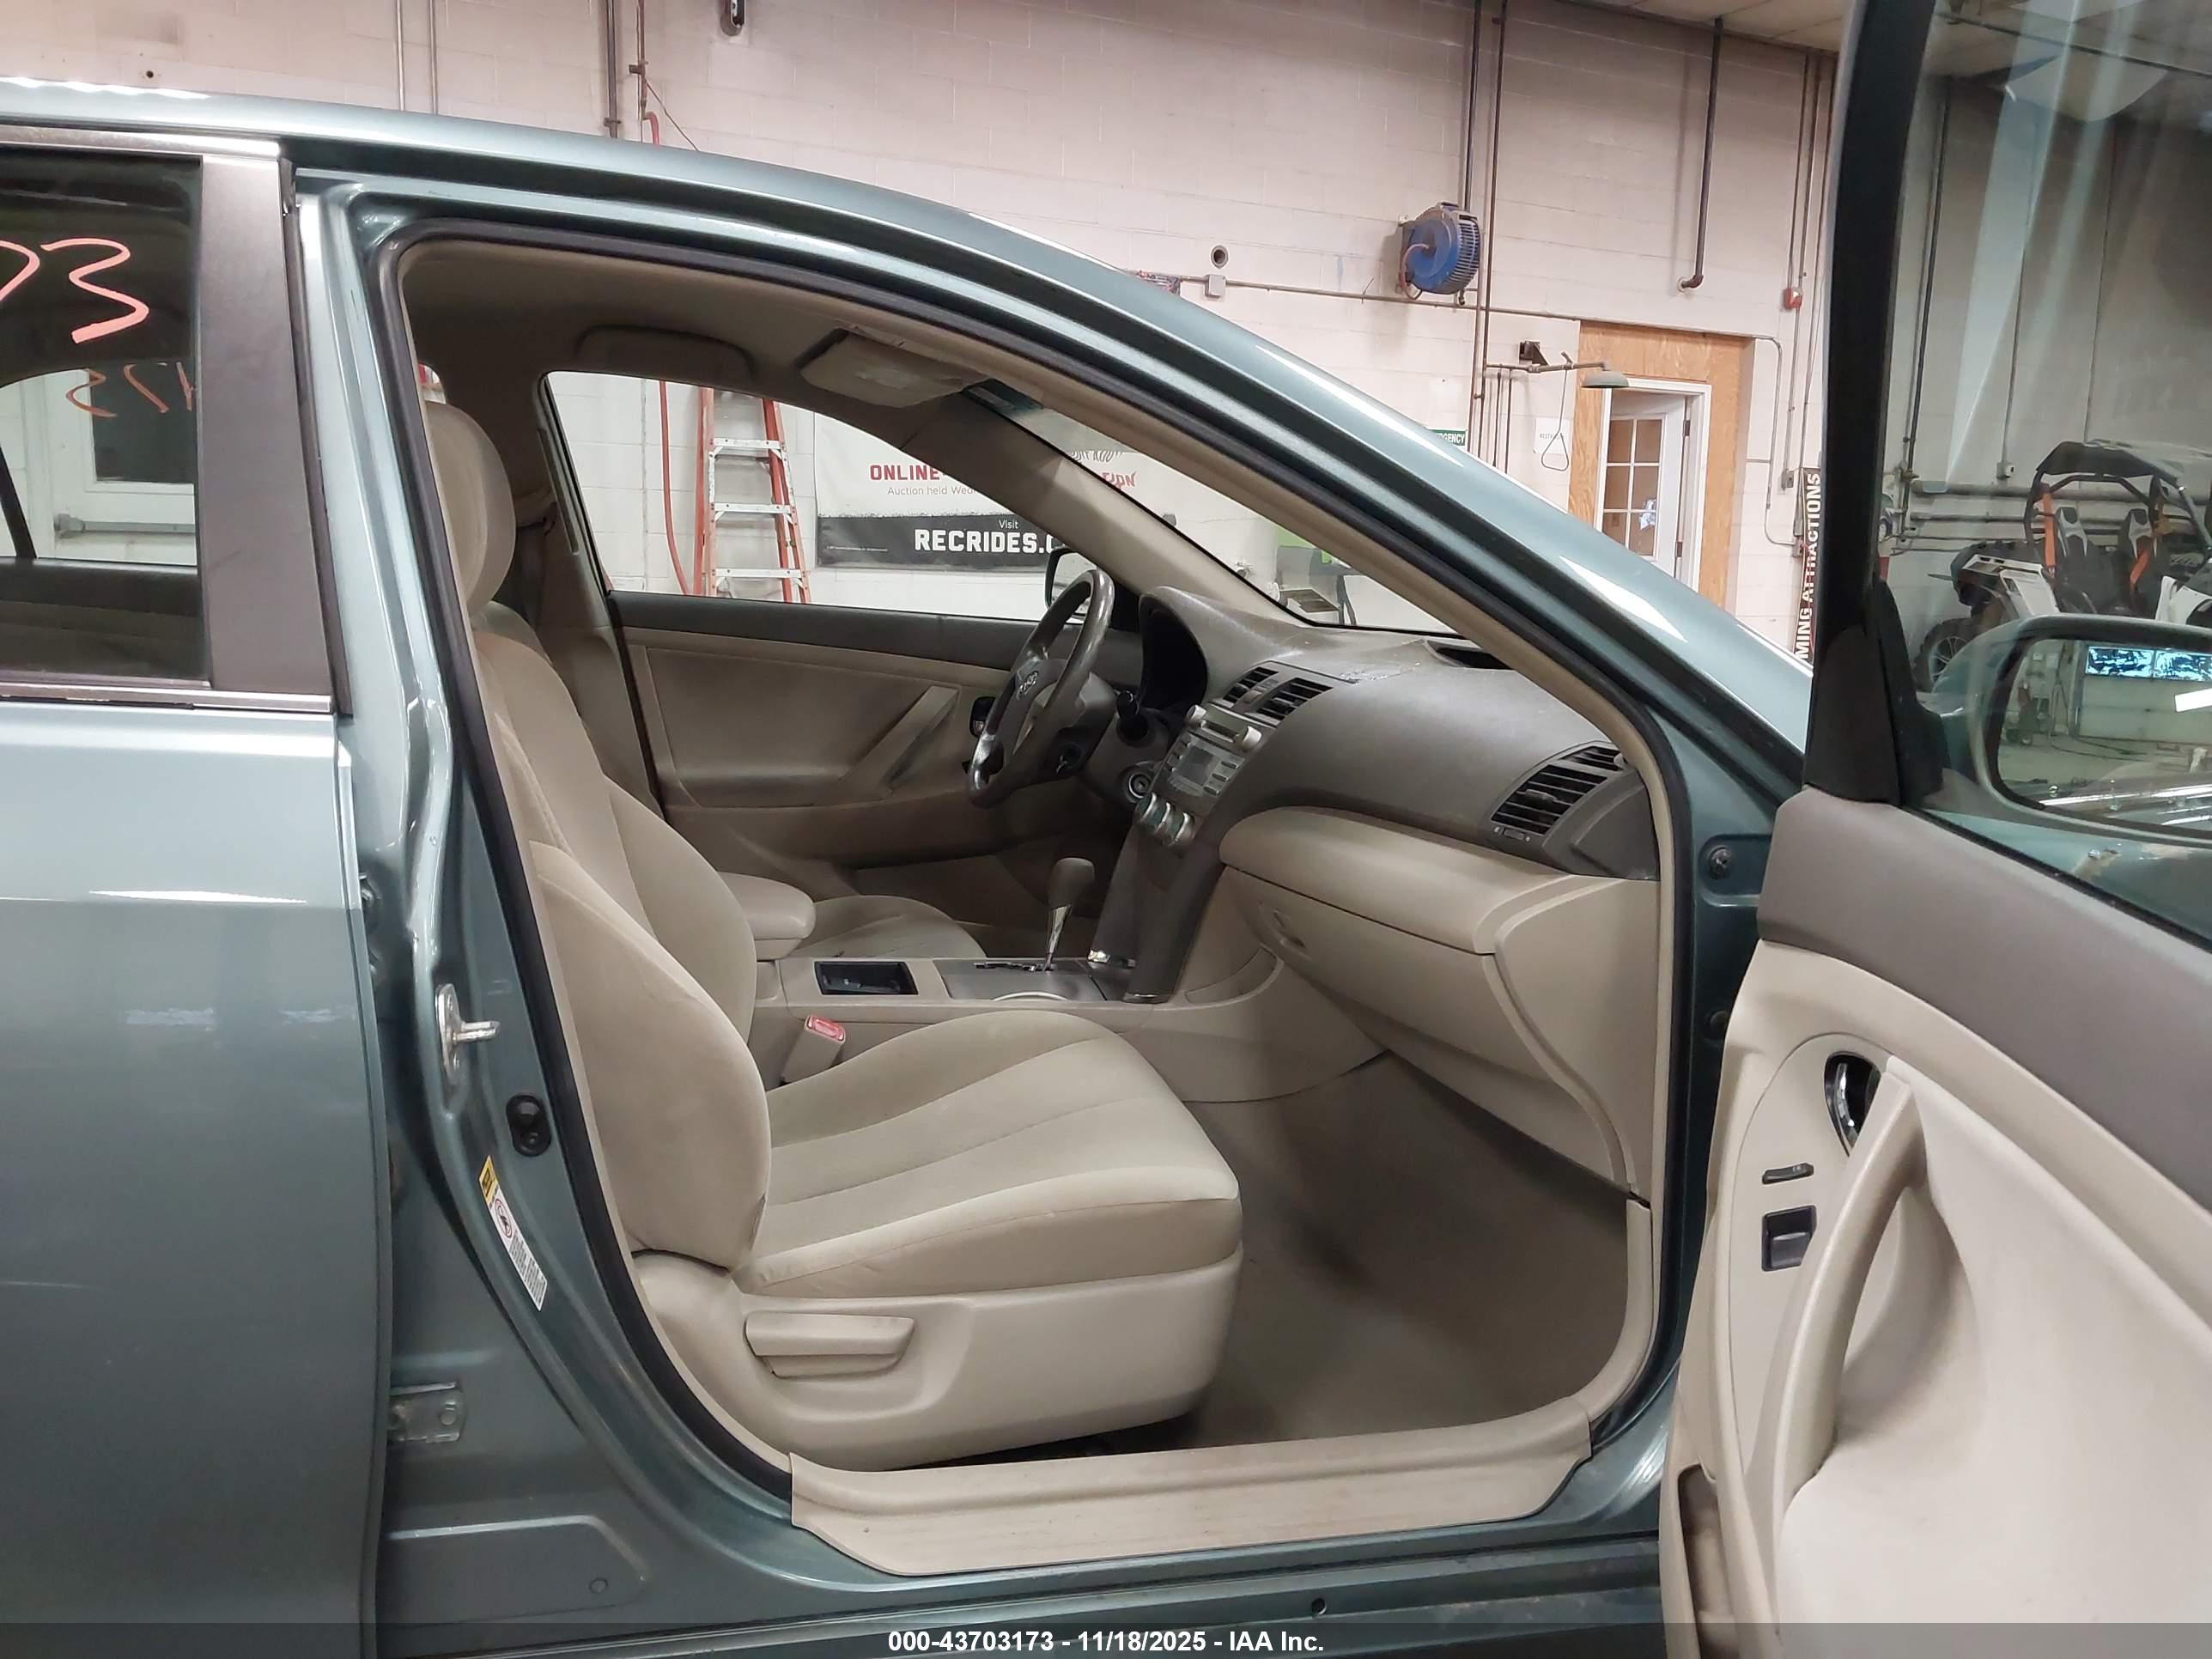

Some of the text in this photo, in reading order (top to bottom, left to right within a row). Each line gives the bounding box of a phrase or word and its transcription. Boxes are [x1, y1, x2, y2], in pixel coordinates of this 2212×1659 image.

[888, 486, 924, 495] Auction
[927, 485, 948, 495] held
[999, 520, 1019, 530] Visit
